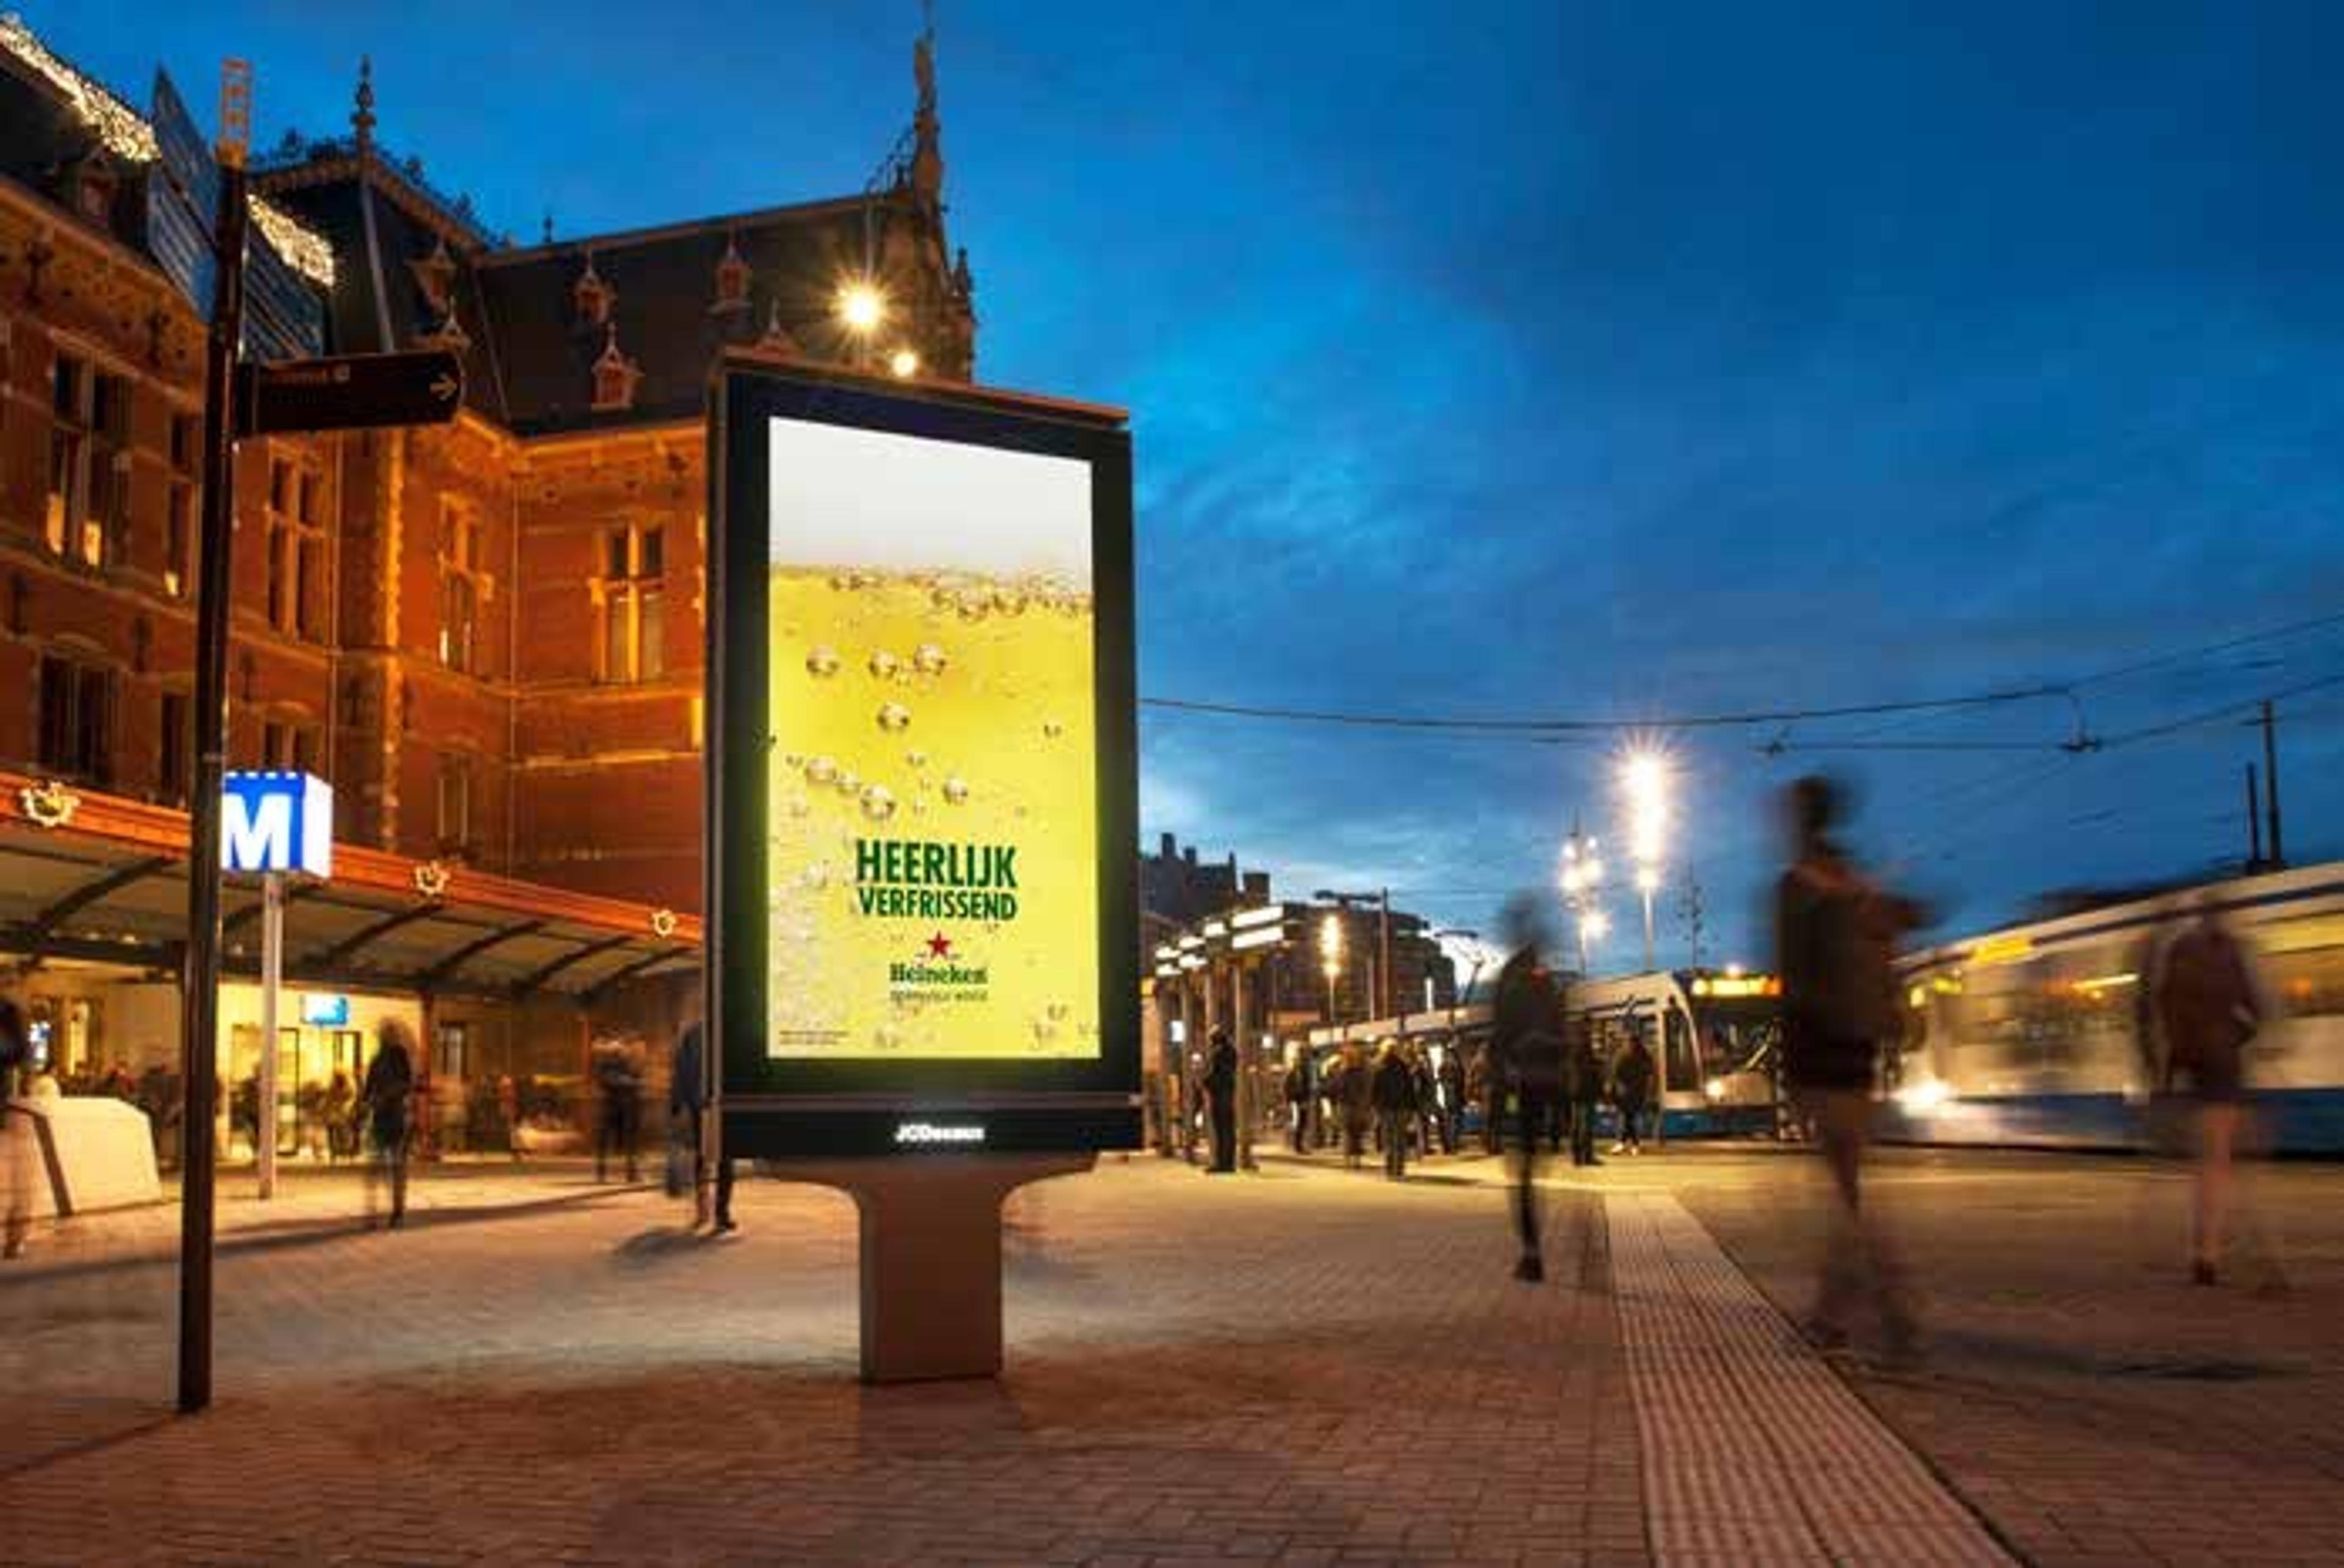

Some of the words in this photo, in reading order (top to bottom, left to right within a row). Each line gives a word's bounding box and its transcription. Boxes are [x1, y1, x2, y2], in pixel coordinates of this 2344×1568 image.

[222, 793, 291, 870] M
[856, 839, 1017, 887] HEERLIJK
[859, 887, 1016, 920] VERFRISSEND
[889, 963, 988, 985] Heineken
